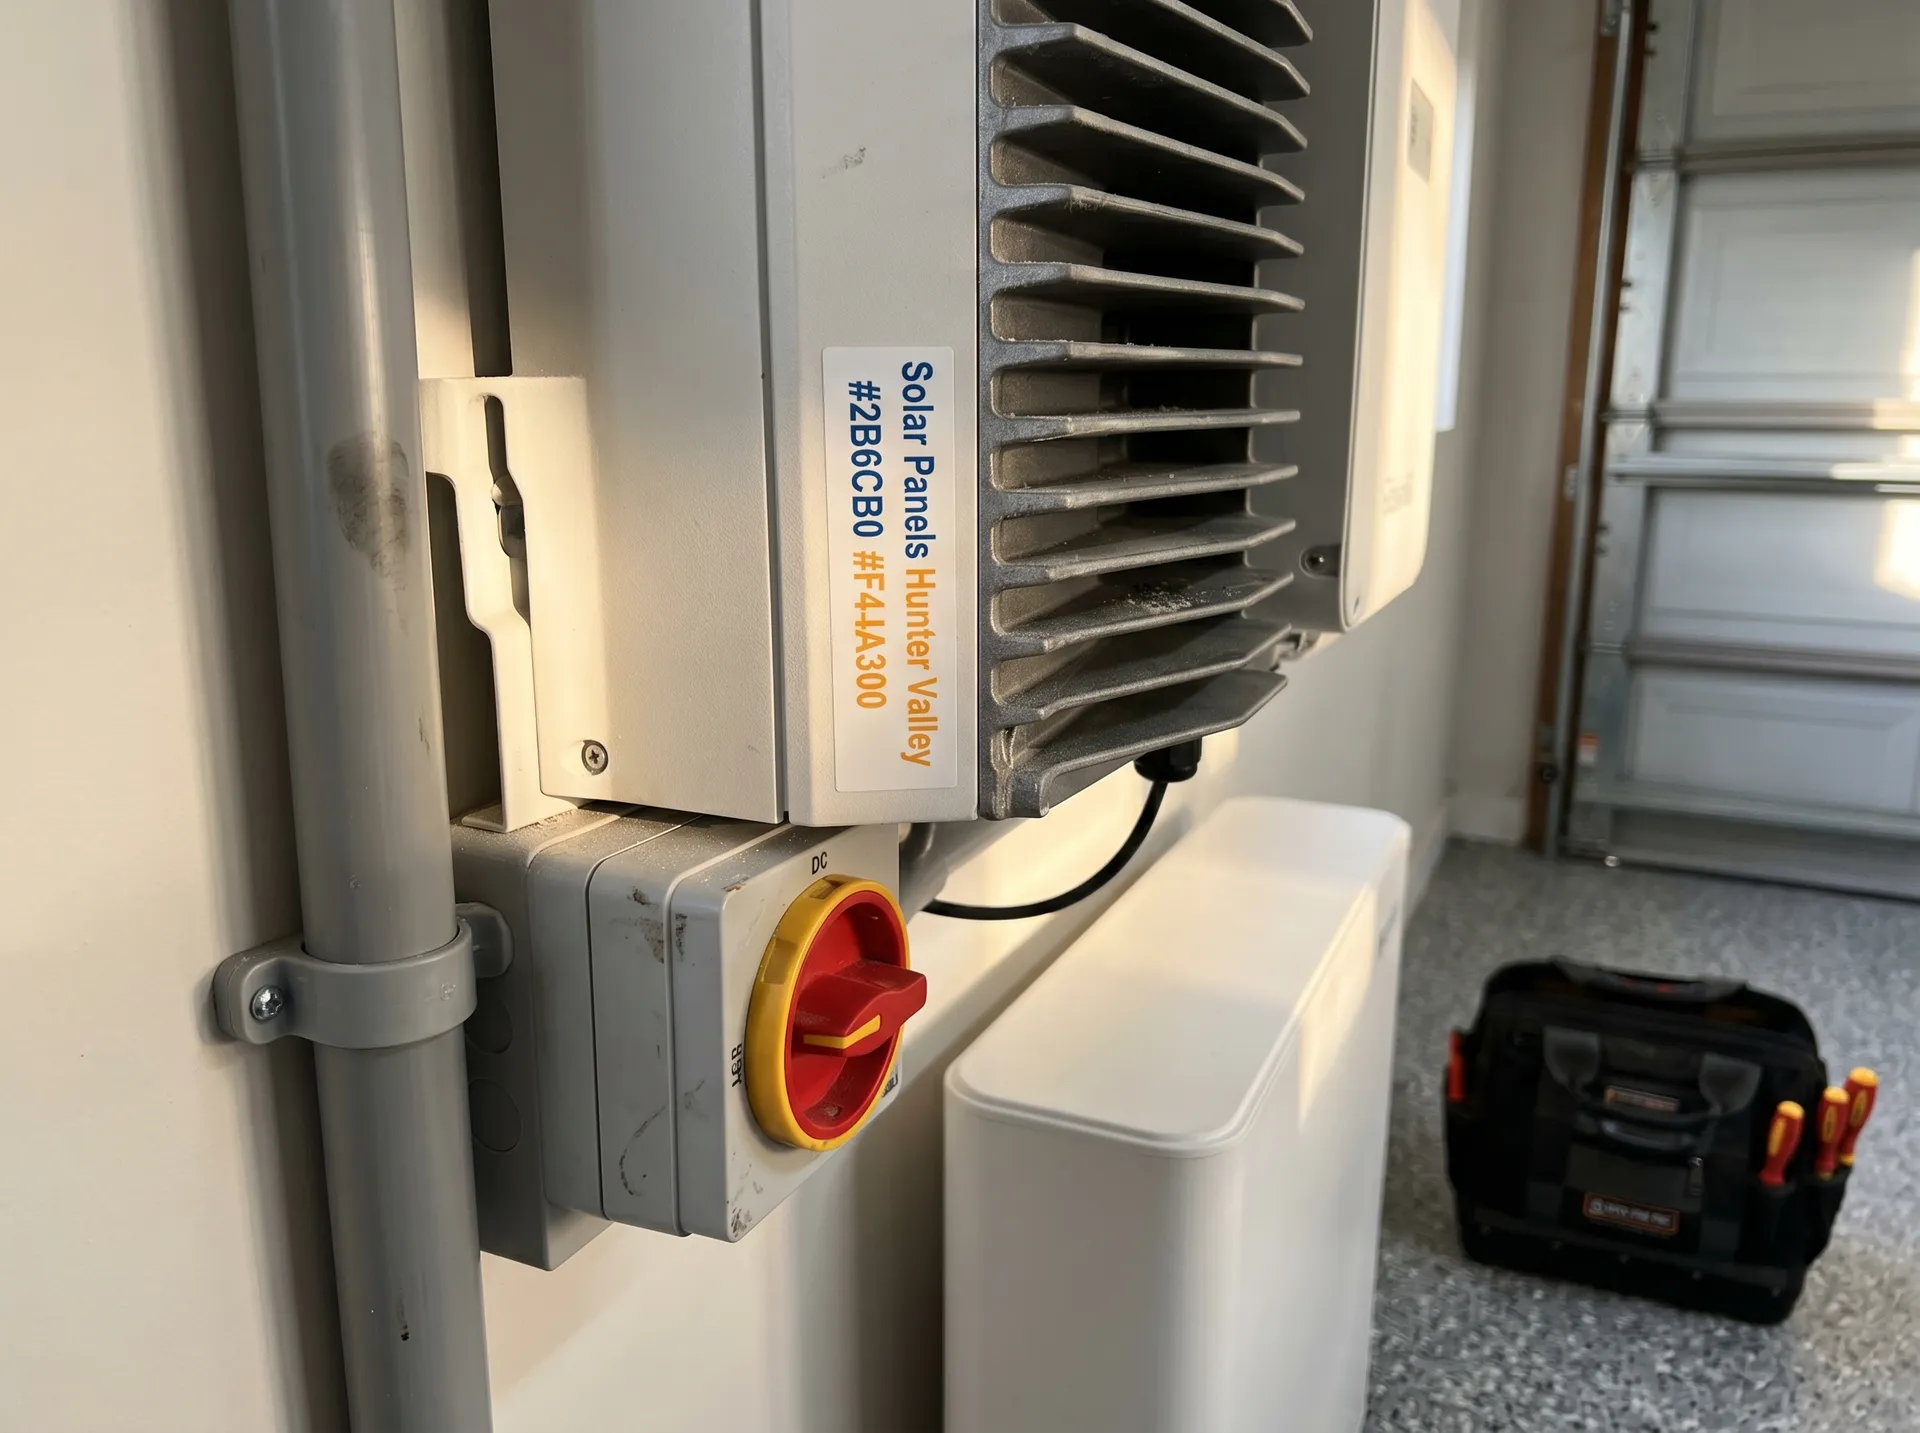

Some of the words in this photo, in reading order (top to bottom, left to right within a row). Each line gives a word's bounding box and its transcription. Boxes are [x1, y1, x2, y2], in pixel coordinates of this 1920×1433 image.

[902, 362, 934, 445] Solar
[849, 381, 883, 537] #2B6CB0
[904, 457, 936, 558] Panels
[905, 568, 936, 671] Hunter
[900, 677, 938, 766] Valley
[812, 852, 827, 875] DC
